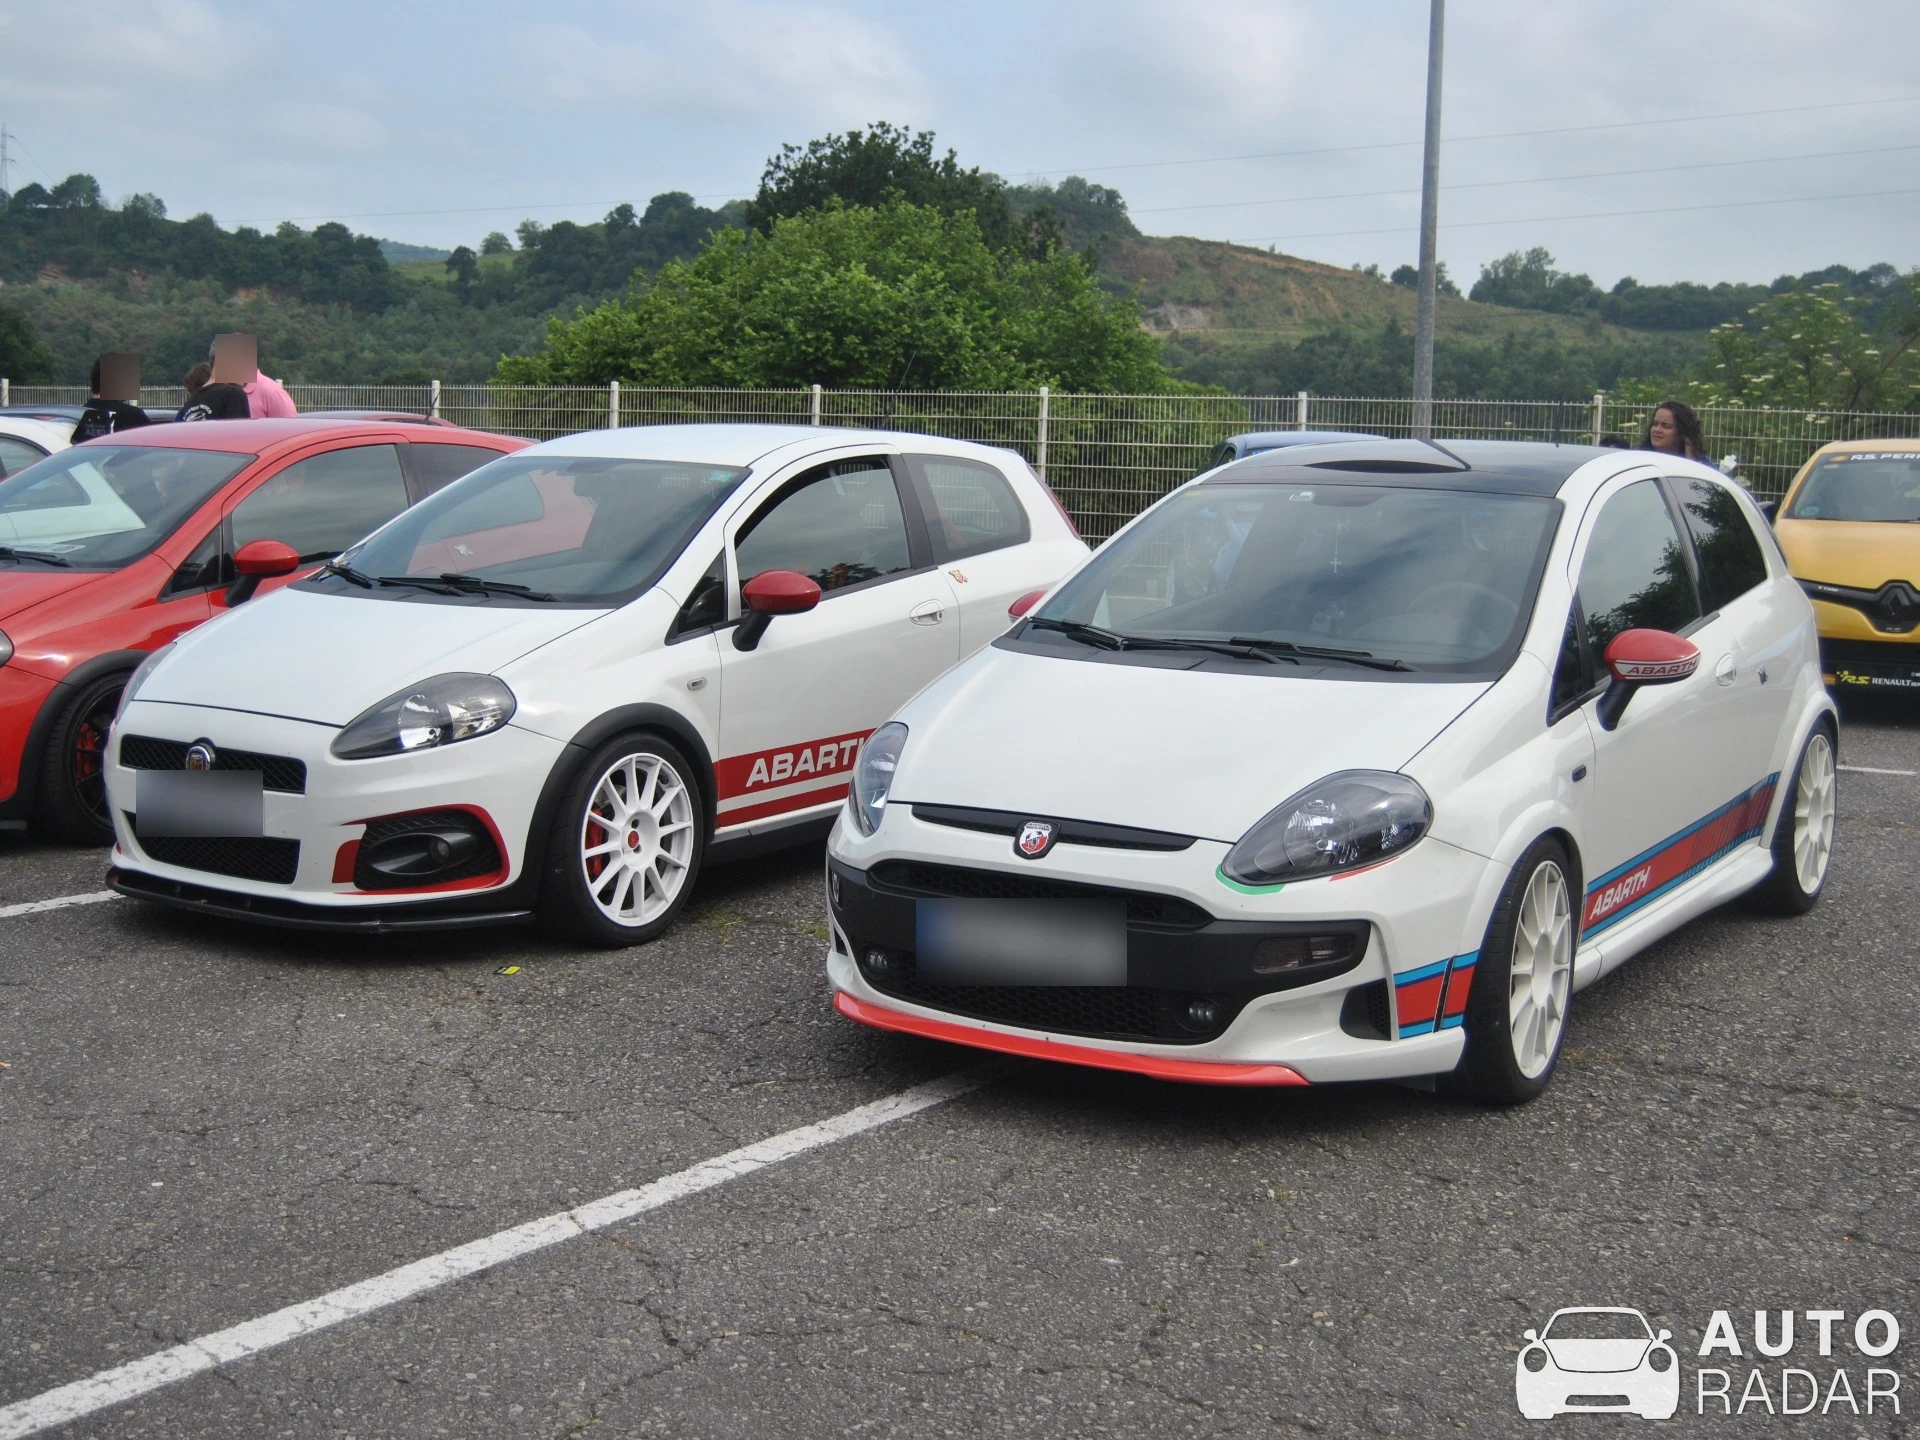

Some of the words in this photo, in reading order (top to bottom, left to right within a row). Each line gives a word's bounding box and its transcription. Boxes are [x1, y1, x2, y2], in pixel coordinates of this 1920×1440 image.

[1627, 659, 1697, 675] ABARTH
[1872, 677, 1912, 687] RENAULT
[1589, 865, 1651, 920] ABARTH
